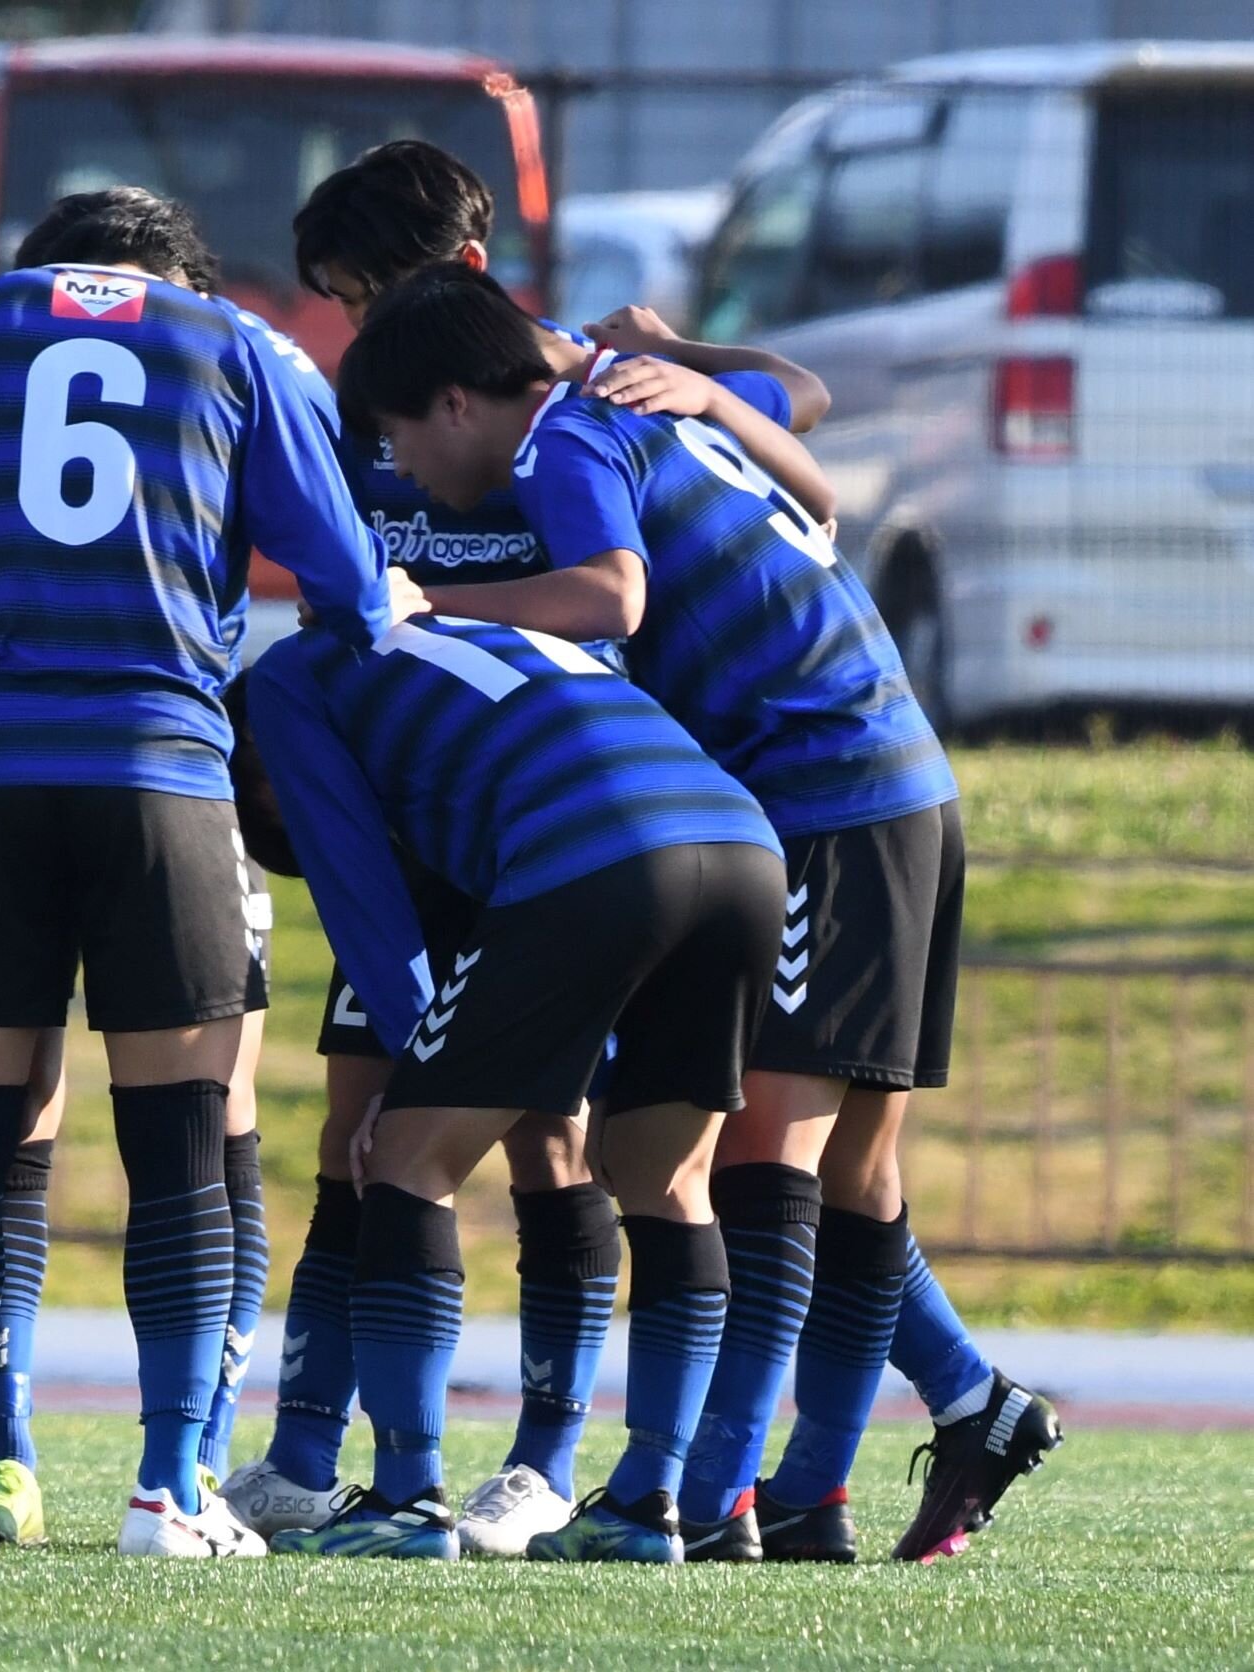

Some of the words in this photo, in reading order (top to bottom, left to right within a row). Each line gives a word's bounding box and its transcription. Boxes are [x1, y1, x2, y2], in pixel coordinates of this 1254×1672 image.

[66, 281, 135, 298] MK
[19, 338, 146, 545] 6
[674, 416, 837, 568] 9
[371, 510, 431, 563] lat
[428, 532, 539, 568] agency
[985, 1387, 1033, 1456] PUMA
[272, 1496, 315, 1514] asics
